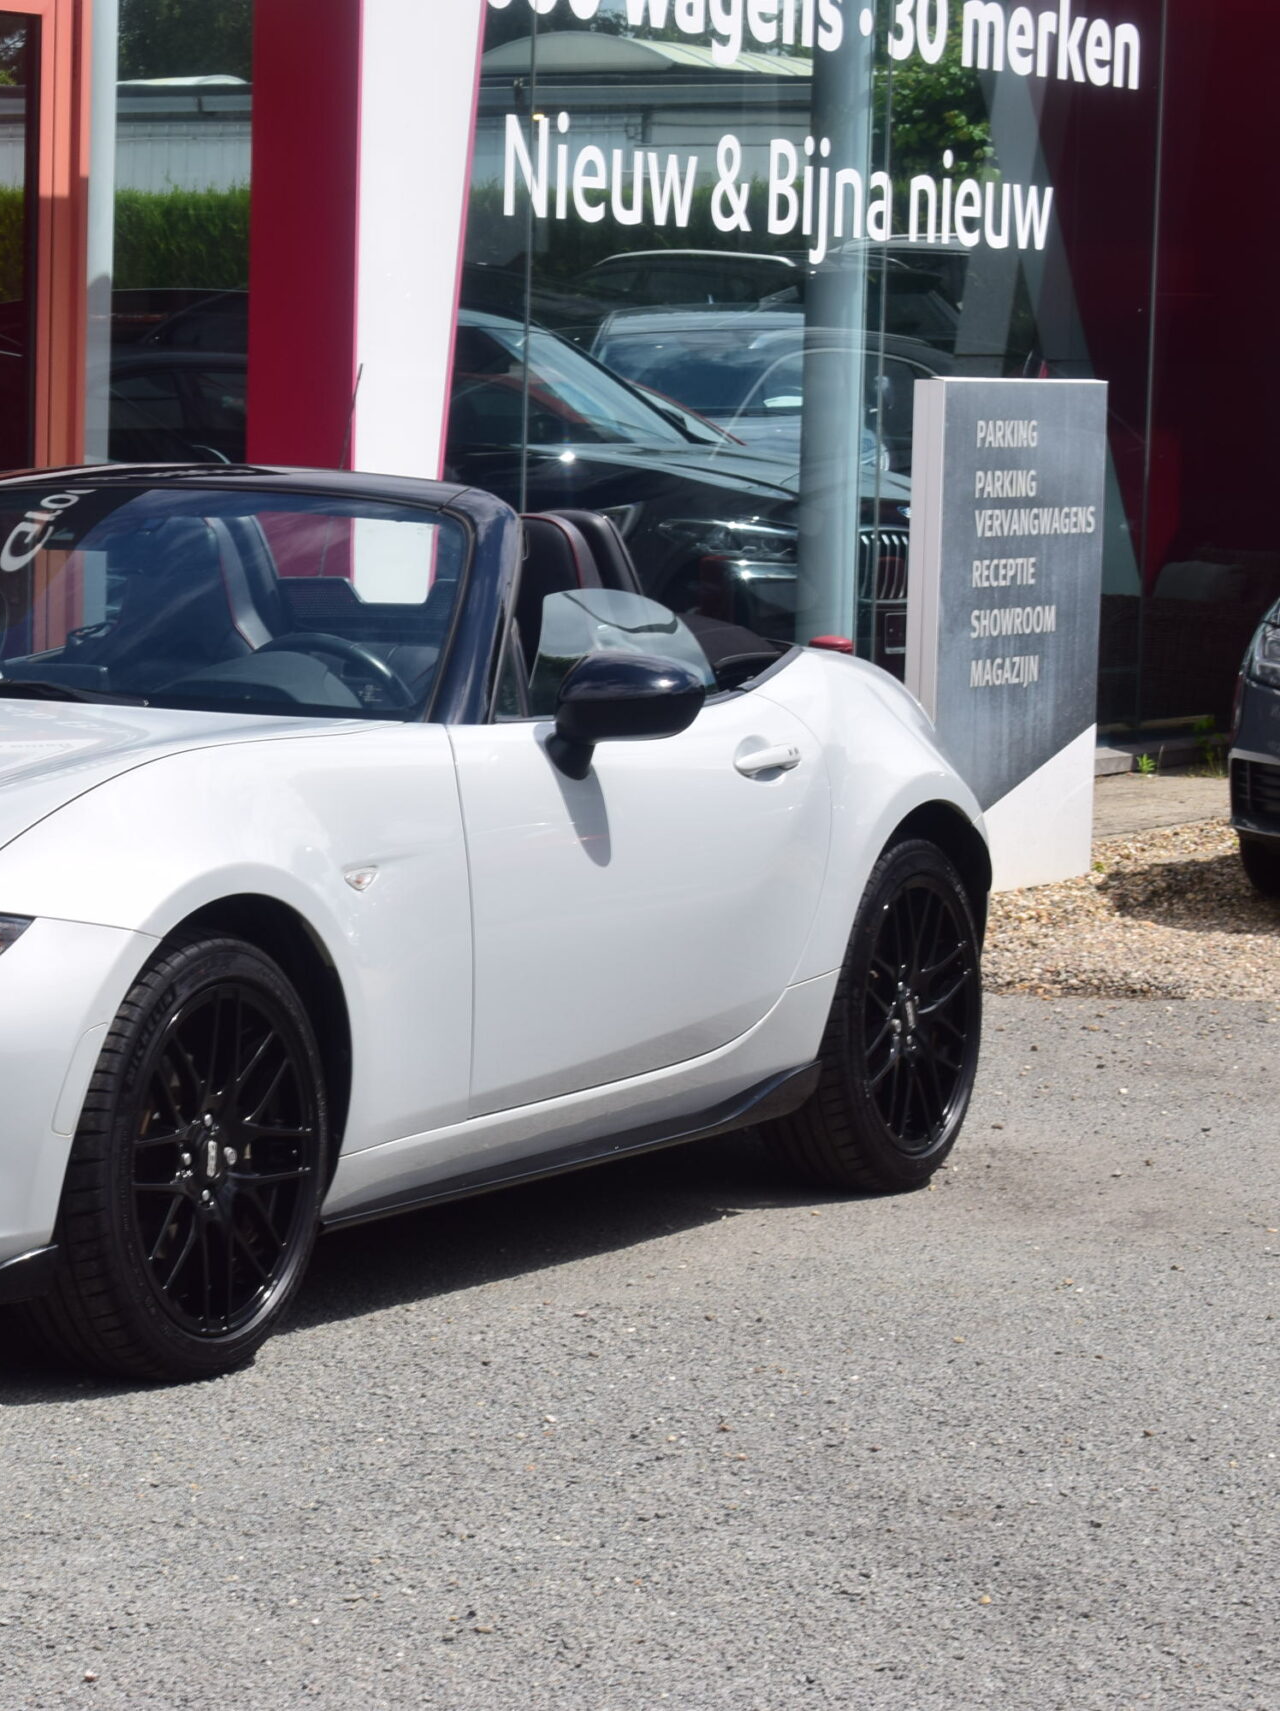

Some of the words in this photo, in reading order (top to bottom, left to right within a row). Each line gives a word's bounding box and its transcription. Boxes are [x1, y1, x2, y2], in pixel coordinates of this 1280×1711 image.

[887, 0, 948, 64] 30
[961, 0, 1141, 90] merken
[503, 111, 698, 227] Nieuw
[711, 134, 752, 232] &
[767, 135, 893, 265] Bijna
[908, 149, 1054, 251] nieuw
[976, 419, 1038, 448] PARKING
[974, 469, 1037, 498] PARKING
[974, 505, 1096, 538] VERVANGWAGENS
[972, 556, 1037, 588] RECEPTIE
[970, 604, 1057, 639] SHOWROOM
[969, 654, 1039, 688] MAGAZIJN
